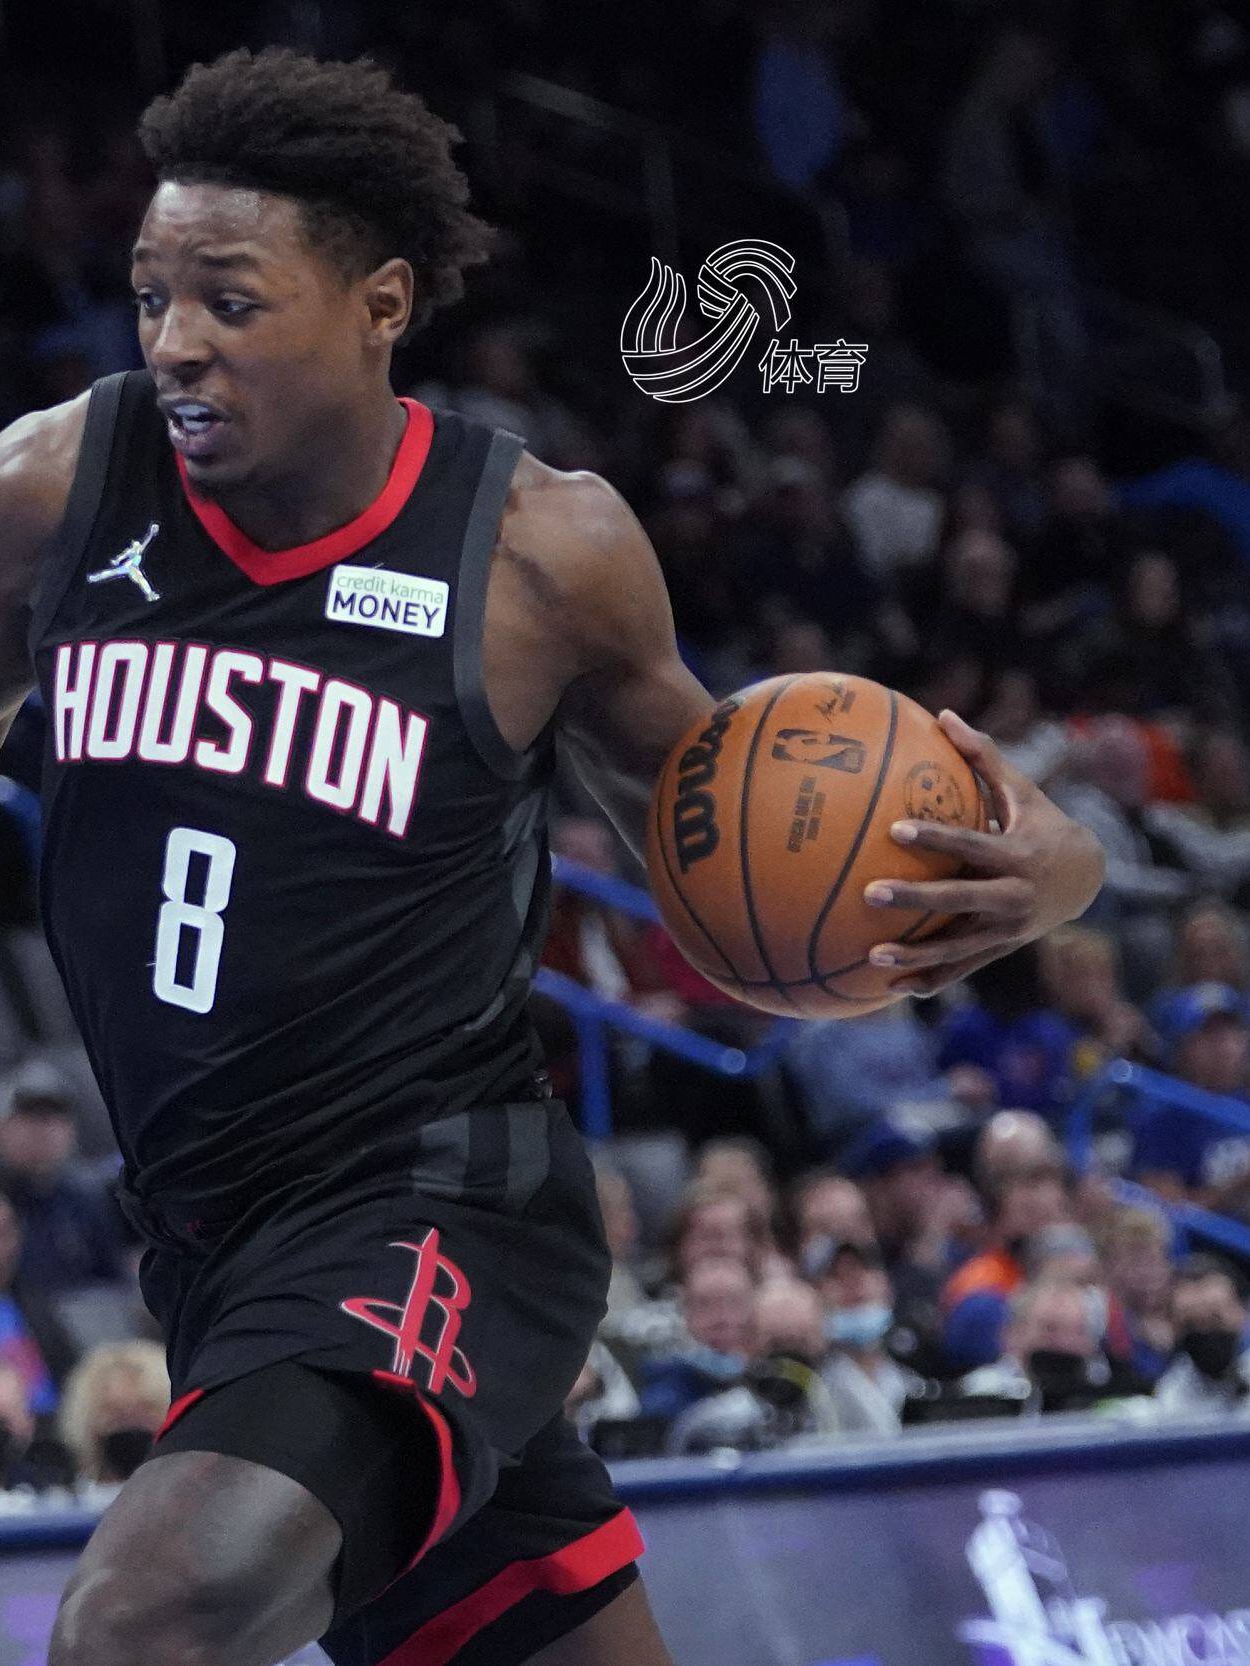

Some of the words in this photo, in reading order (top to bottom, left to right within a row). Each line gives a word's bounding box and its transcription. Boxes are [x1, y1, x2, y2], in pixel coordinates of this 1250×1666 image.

[332, 589, 440, 629] MONEY
[336, 575, 388, 594] credit
[390, 577, 444, 604] karma
[54, 640, 430, 839] HOUSTON
[152, 826, 237, 1014] 8
